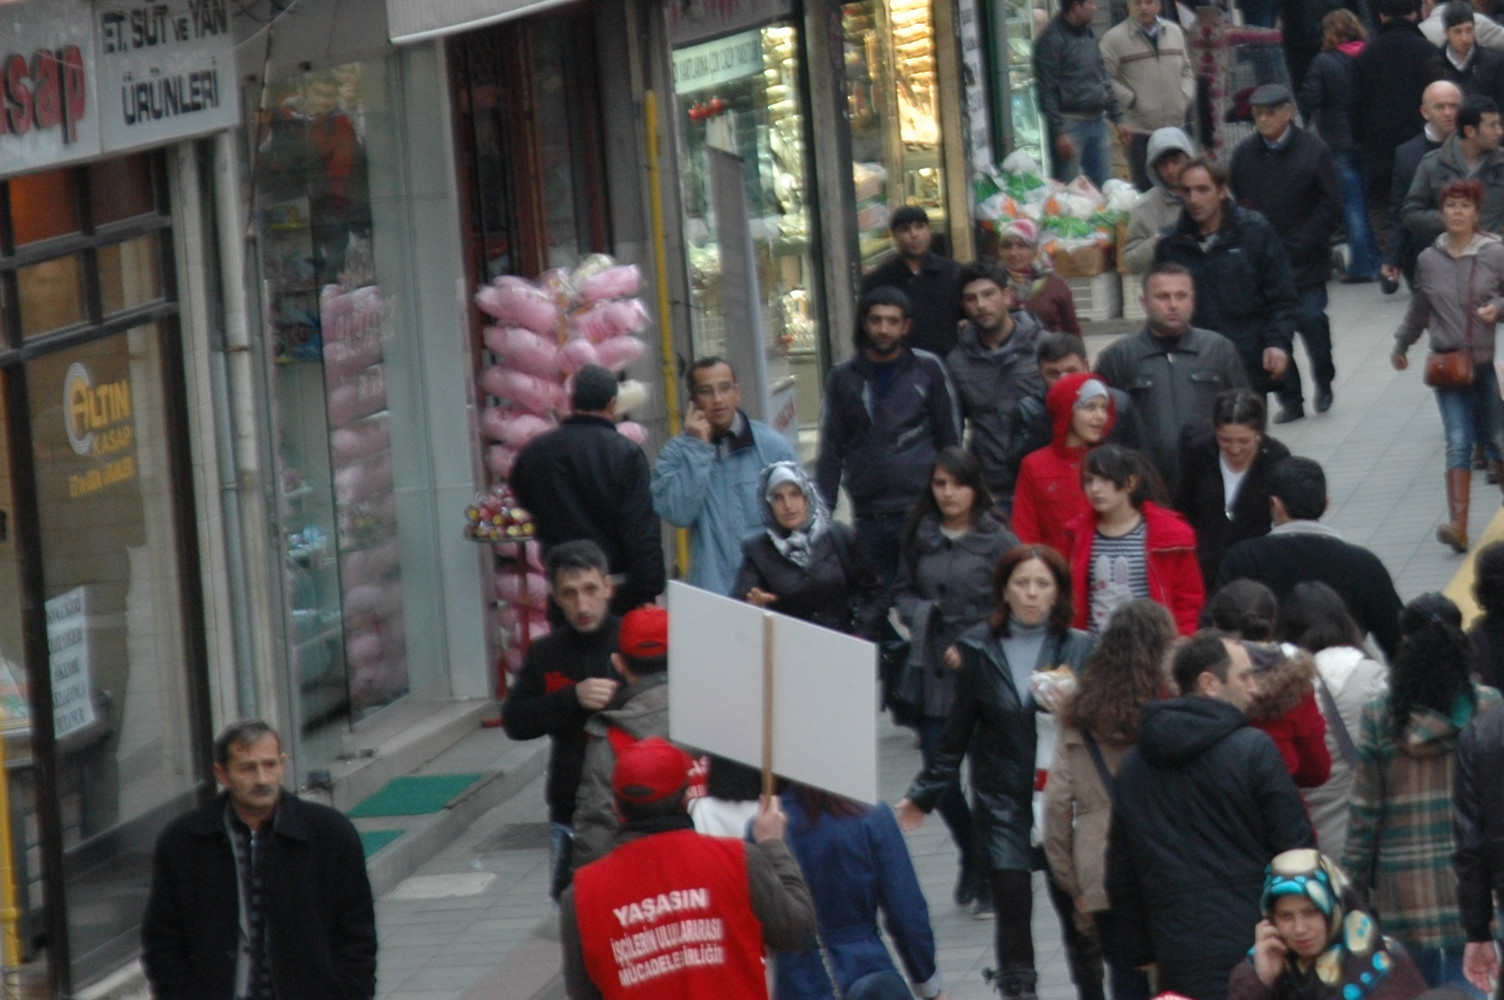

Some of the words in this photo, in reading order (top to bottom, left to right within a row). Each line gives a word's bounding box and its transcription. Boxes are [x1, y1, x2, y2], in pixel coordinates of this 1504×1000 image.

[0, 44, 85, 145] sap
[122, 56, 220, 126] ÜRÜNLERİ
[70, 377, 133, 432] ALTIN
[612, 887, 710, 927] YAŞASIN
[618, 950, 682, 988] MÜCADELE
